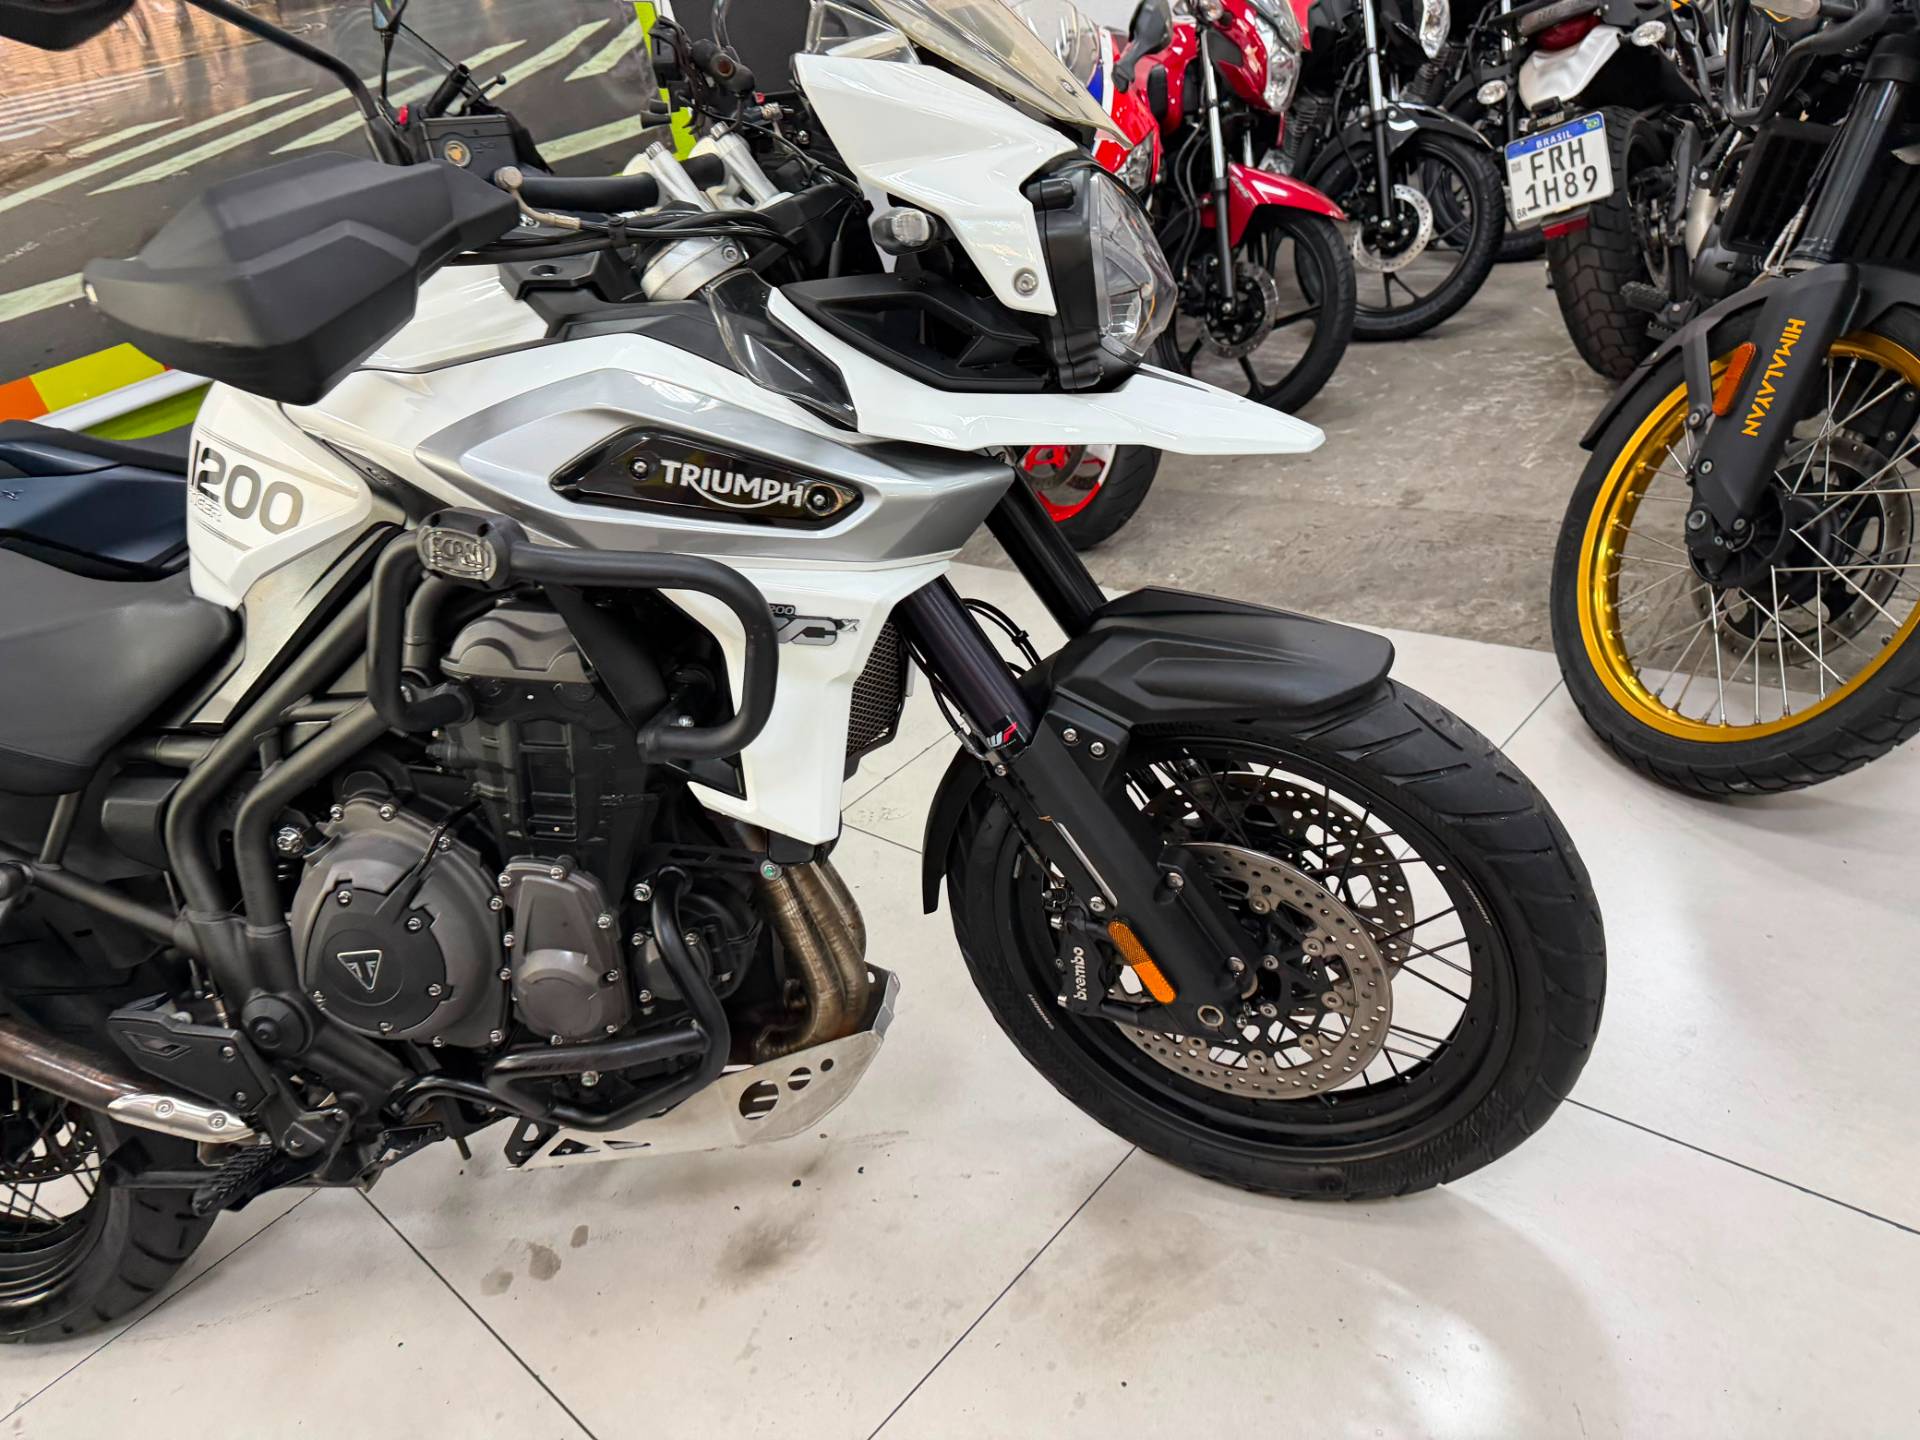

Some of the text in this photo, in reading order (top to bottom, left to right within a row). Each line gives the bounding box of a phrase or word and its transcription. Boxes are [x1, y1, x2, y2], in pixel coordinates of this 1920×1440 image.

[1529, 137, 1586, 181] FRH
[1536, 130, 1573, 149] BRASIL
[1525, 165, 1598, 212] 1H89
[1742, 318, 1807, 437] HIMALAYAN
[660, 459, 804, 509] TRIUMPH
[1071, 946, 1088, 1001] brembo
